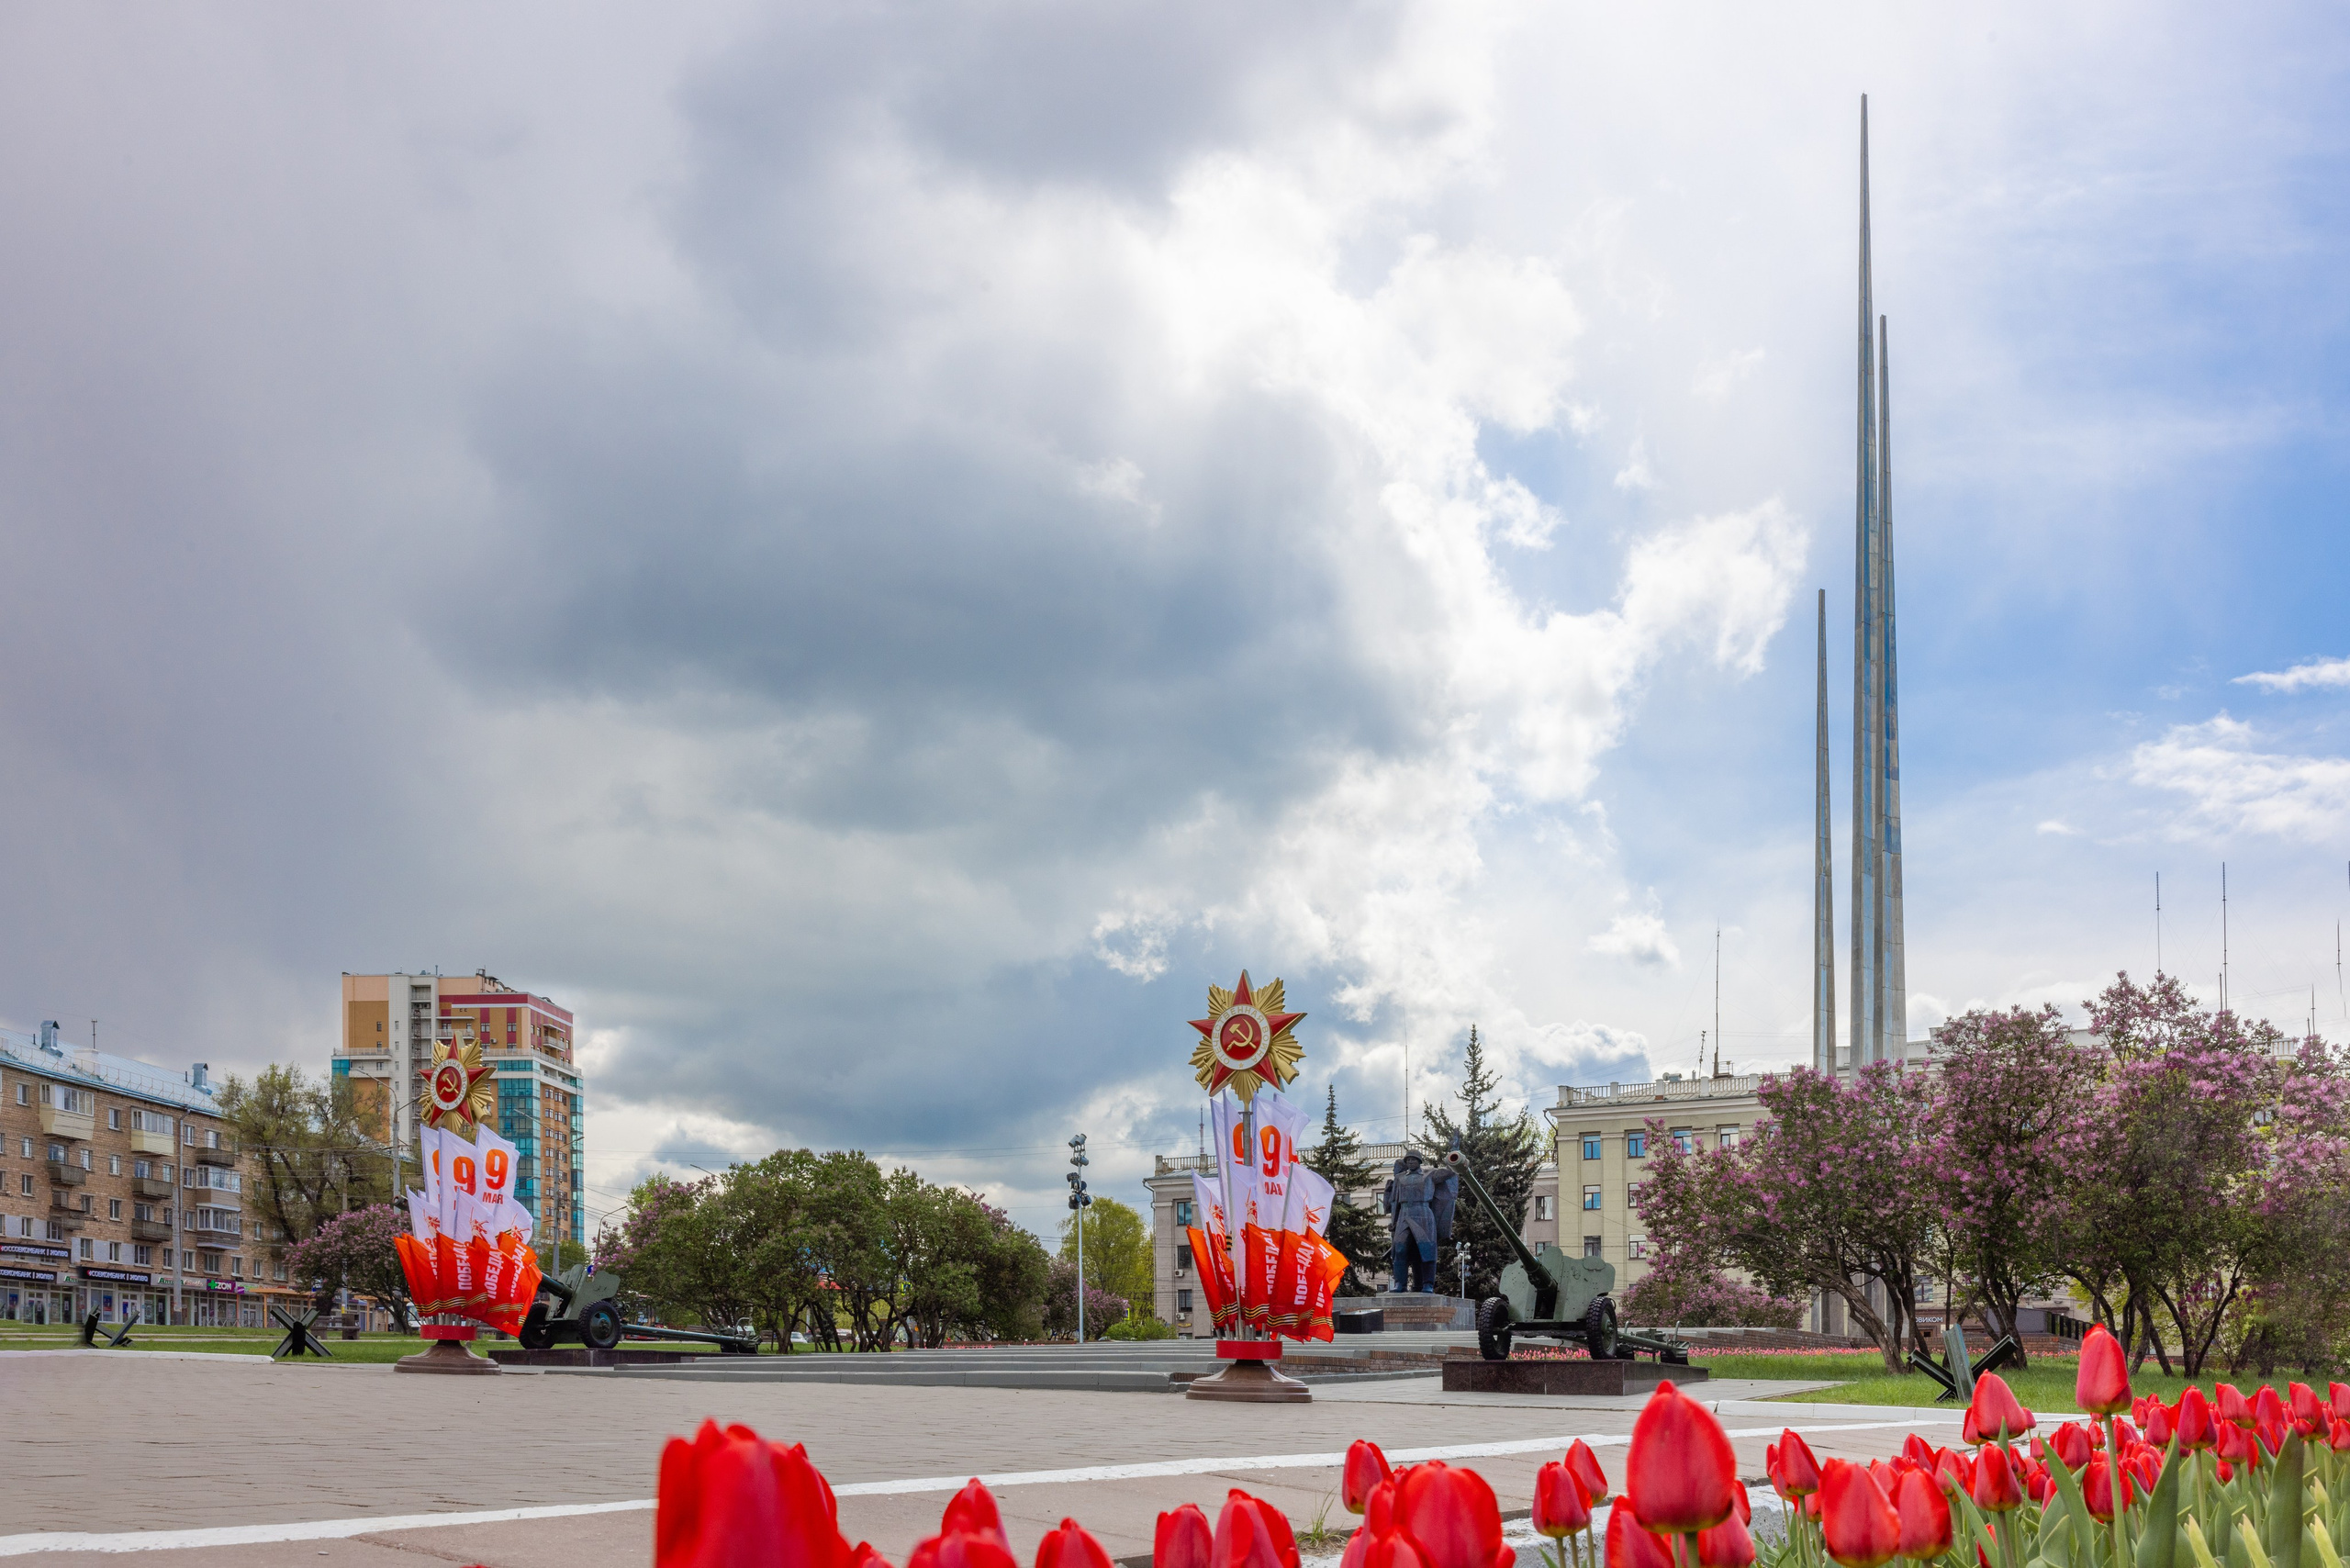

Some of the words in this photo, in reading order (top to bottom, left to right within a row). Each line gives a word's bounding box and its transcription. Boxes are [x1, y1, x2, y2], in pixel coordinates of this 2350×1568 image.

[1213, 1006, 1264, 1065] ОТЕЧЕСТВЕННАЯ
[485, 1148, 509, 1191] 9
[1259, 1125, 1281, 1178] 9
[453, 1156, 476, 1196] 9
[482, 1192, 504, 1205] МАЯ
[216, 1282, 232, 1291] ZON
[453, 1242, 473, 1291] ПОБЕДА!
[1293, 1240, 1315, 1306] ПОБЕДА!
